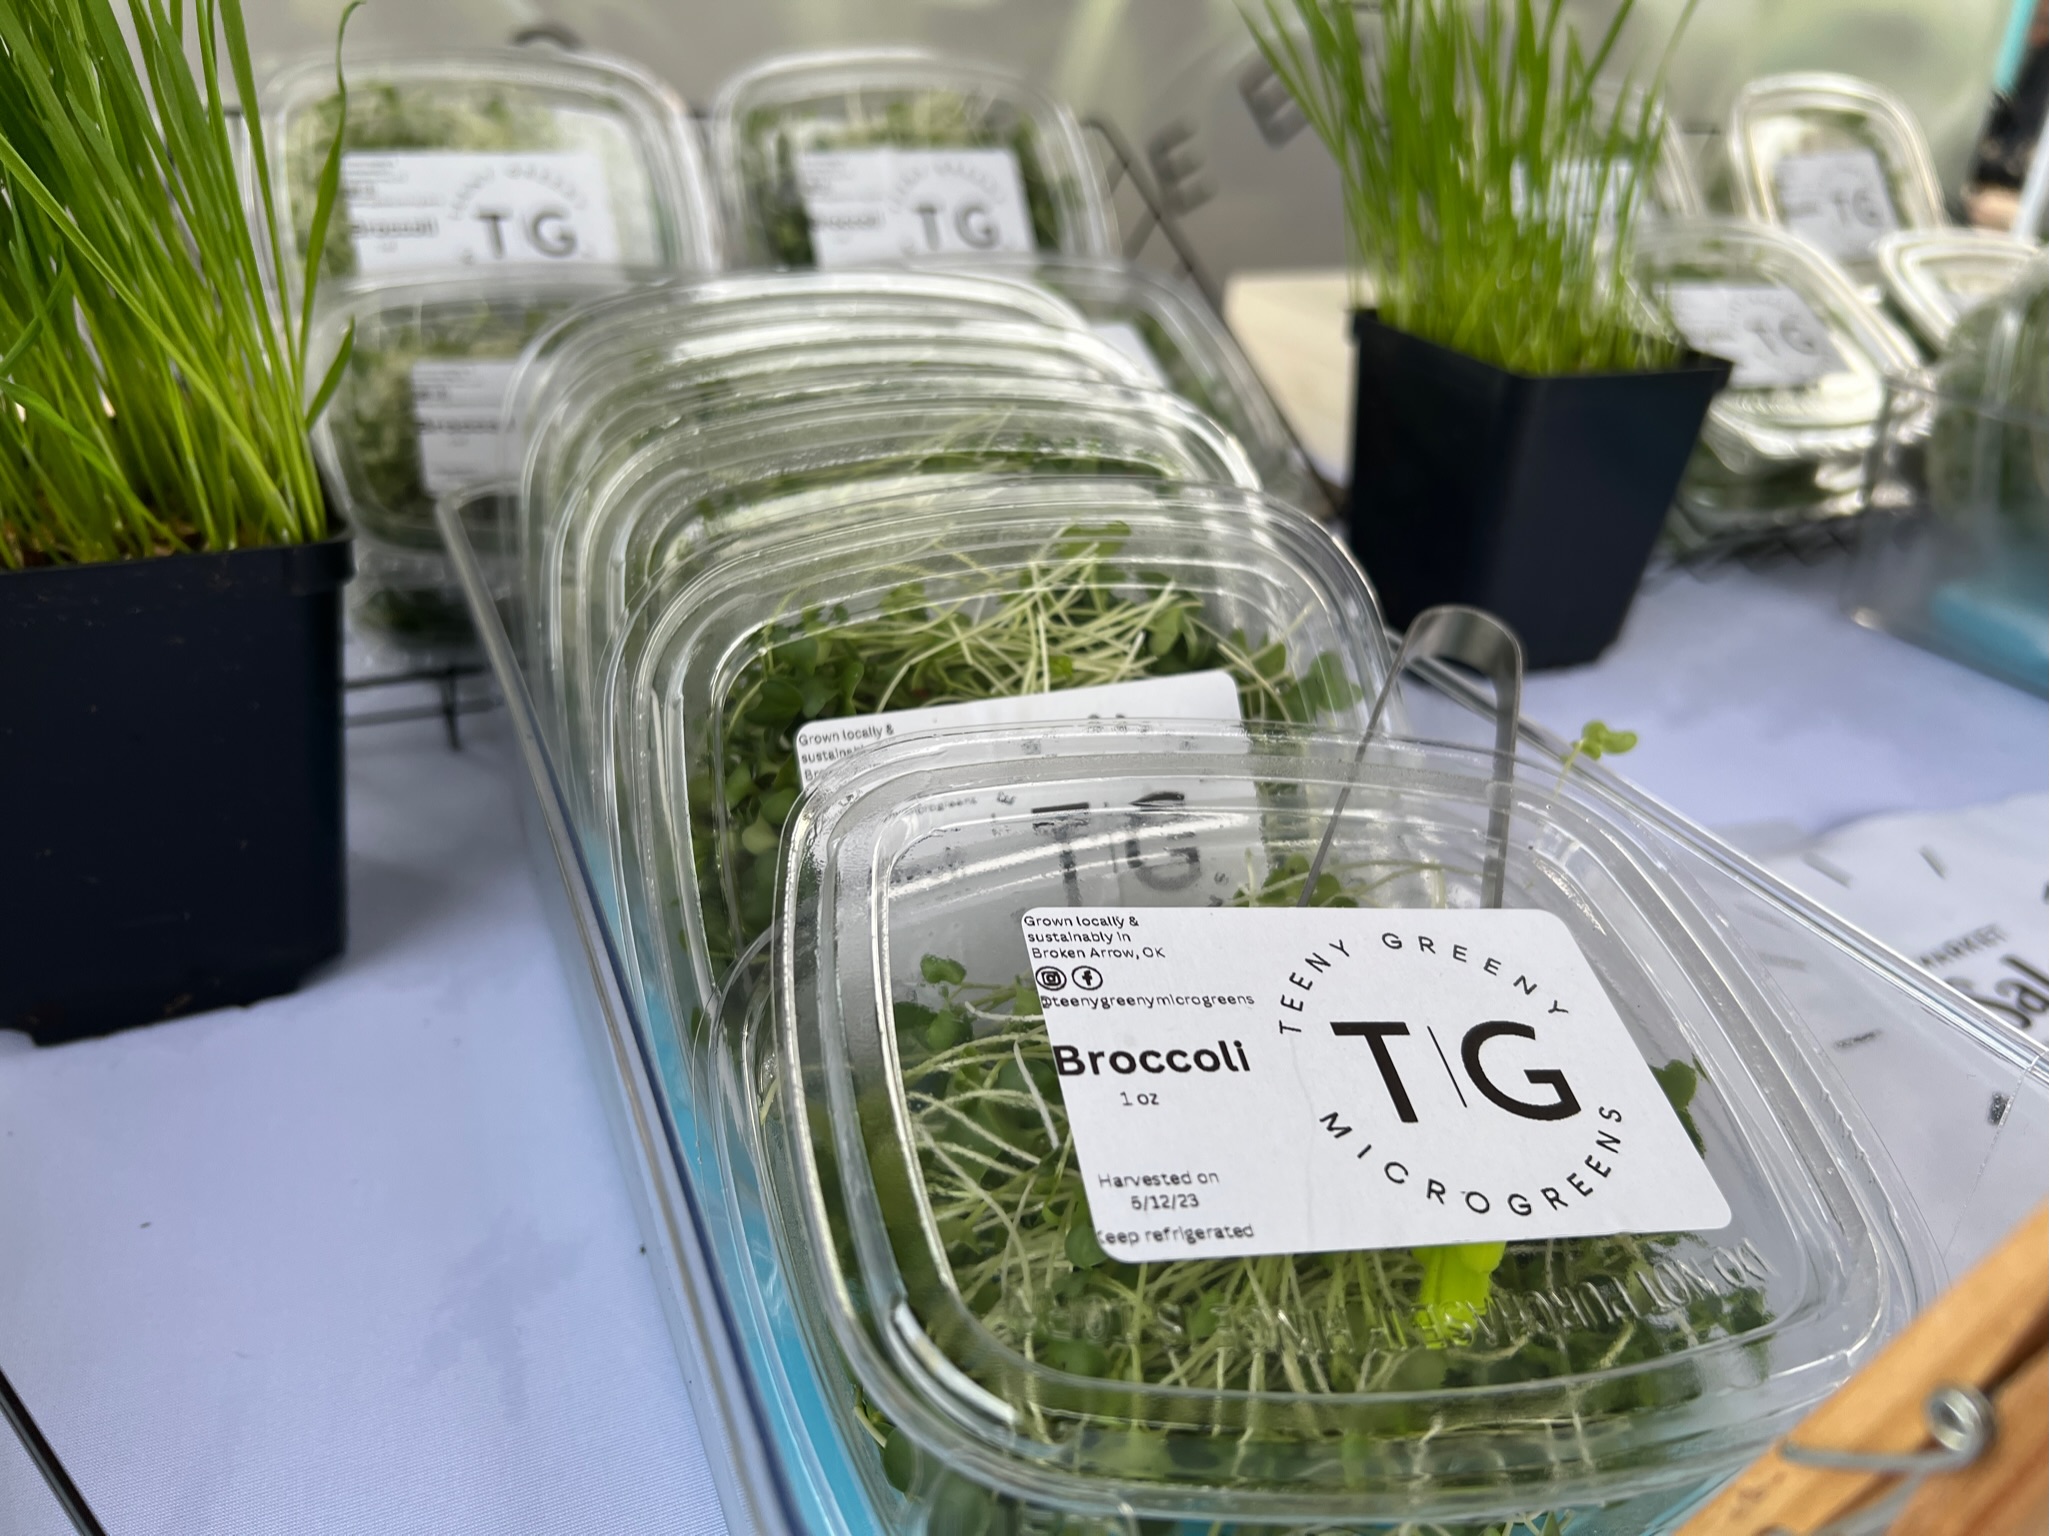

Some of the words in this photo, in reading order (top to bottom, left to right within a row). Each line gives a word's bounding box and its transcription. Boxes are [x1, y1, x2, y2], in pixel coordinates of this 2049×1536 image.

[799, 733, 840, 747] Grown
[842, 725, 883, 740] locally
[886, 723, 895, 736] &
[1024, 916, 1073, 927] Grown
[1076, 915, 1125, 928] locally
[1129, 916, 1140, 927] &
[1028, 931, 1113, 945] sustainably
[1117, 931, 1131, 942] in
[1032, 947, 1085, 959] Broken
[1090, 947, 1140, 960] Arrow,
[1142, 947, 1166, 958] OK
[1381, 932, 1569, 1015] GREENY
[1278, 939, 1351, 1035] TEENY
[1052, 1040, 1251, 1076] Broccoli
[1120, 1091, 1133, 1106] 1
[1136, 1093, 1160, 1106] oz
[1319, 1106, 1622, 1216] MICROGREENS
[1098, 1171, 1193, 1188] Harvested
[1197, 1173, 1220, 1184] on
[1131, 1193, 1200, 1211] 5/12/23
[1145, 1223, 1255, 1245] refrigerated
